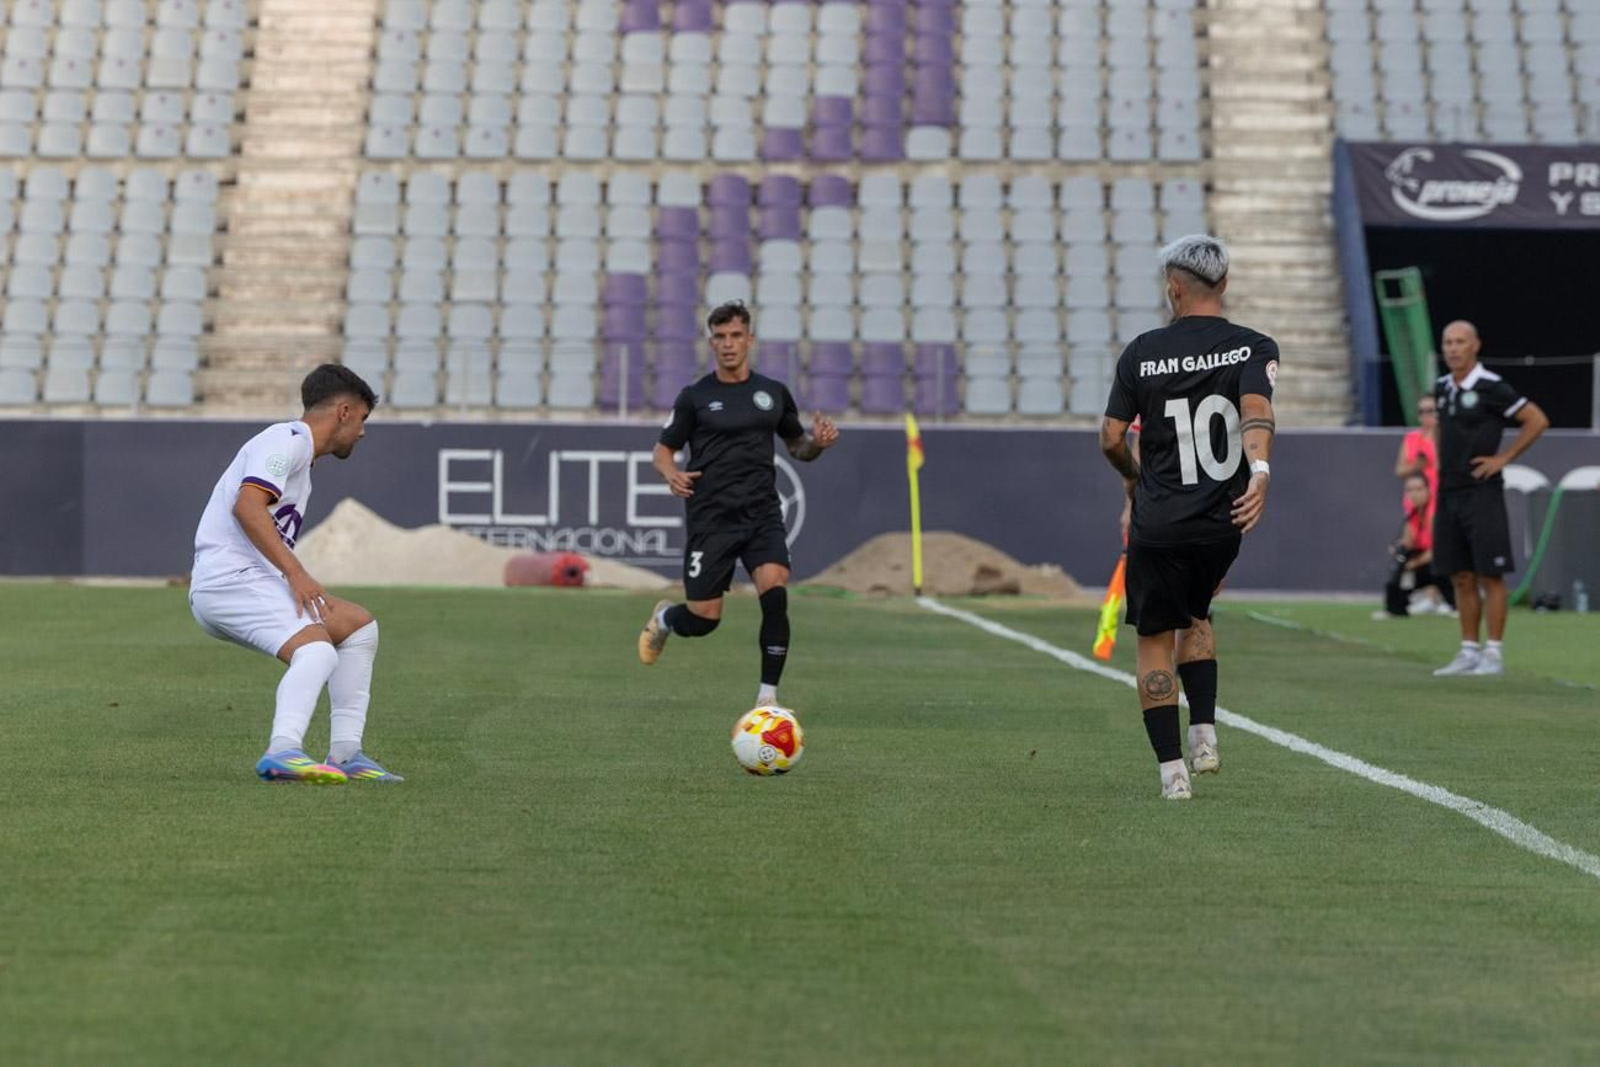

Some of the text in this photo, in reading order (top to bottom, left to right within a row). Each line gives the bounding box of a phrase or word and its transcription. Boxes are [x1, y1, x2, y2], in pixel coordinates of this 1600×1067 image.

[1549, 191, 1574, 215] Y
[1140, 346, 1251, 377] FRAN GALLEGO
[1164, 394, 1243, 485] 10
[438, 450, 683, 526] ELITE
[462, 527, 683, 556] TERNACIONAL
[688, 551, 704, 578] 3
